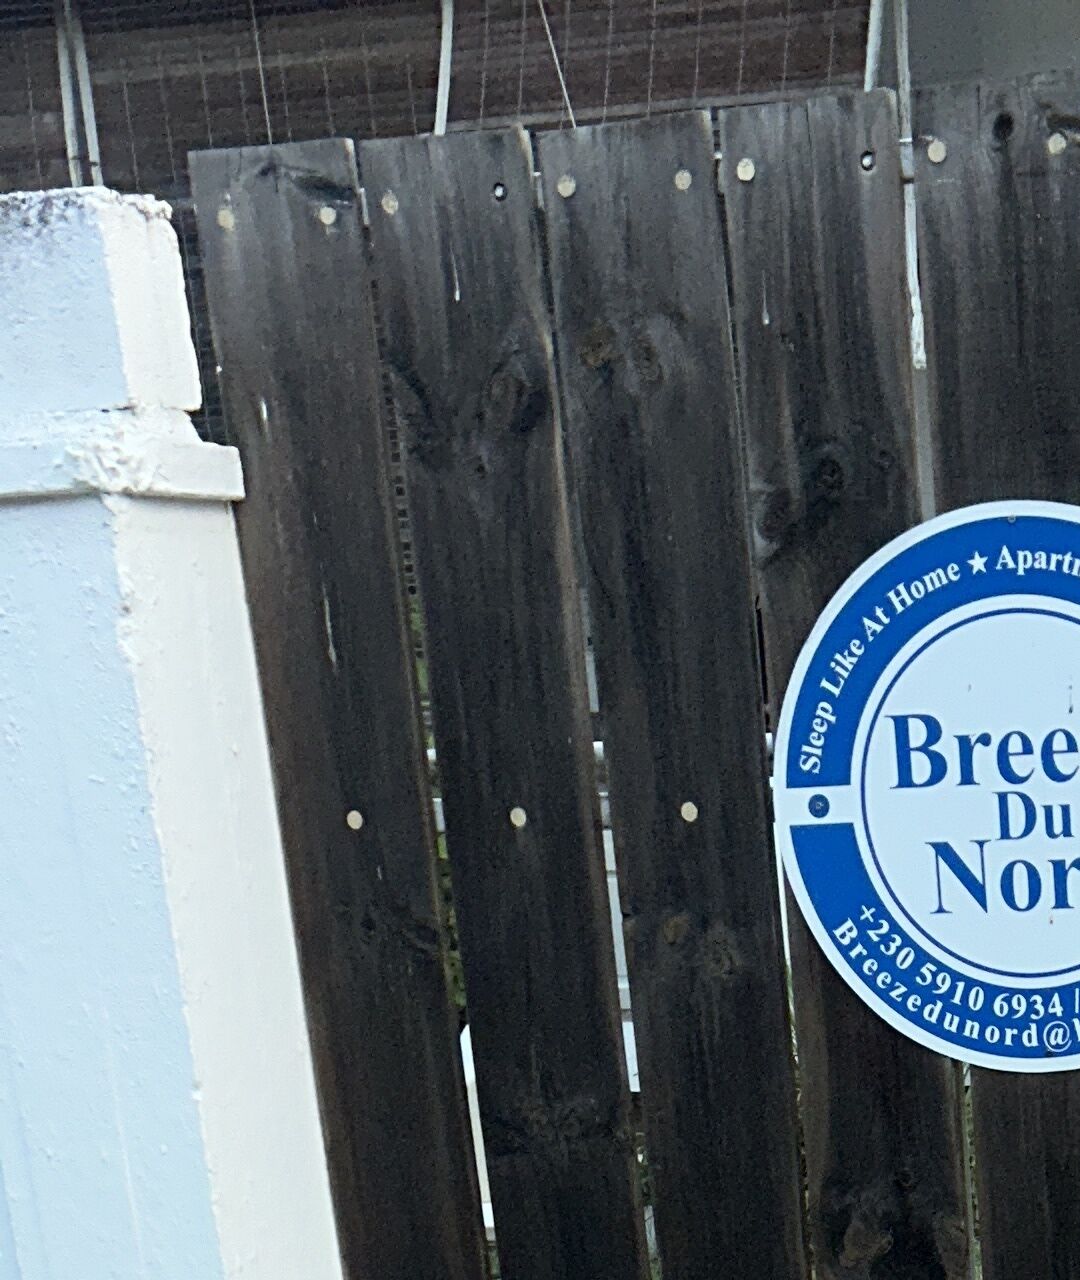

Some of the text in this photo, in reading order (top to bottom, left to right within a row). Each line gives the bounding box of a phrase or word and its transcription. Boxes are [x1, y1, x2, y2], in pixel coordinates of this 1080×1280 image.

[799, 701, 837, 775] Sleep
[820, 639, 865, 698] Like
[862, 606, 891, 642] At
[887, 562, 961, 614] Home
[994, 790, 1074, 841] Du
[860, 905, 915, 970] +230
[915, 962, 985, 1011] 5910
[993, 992, 1064, 1020] 6934
